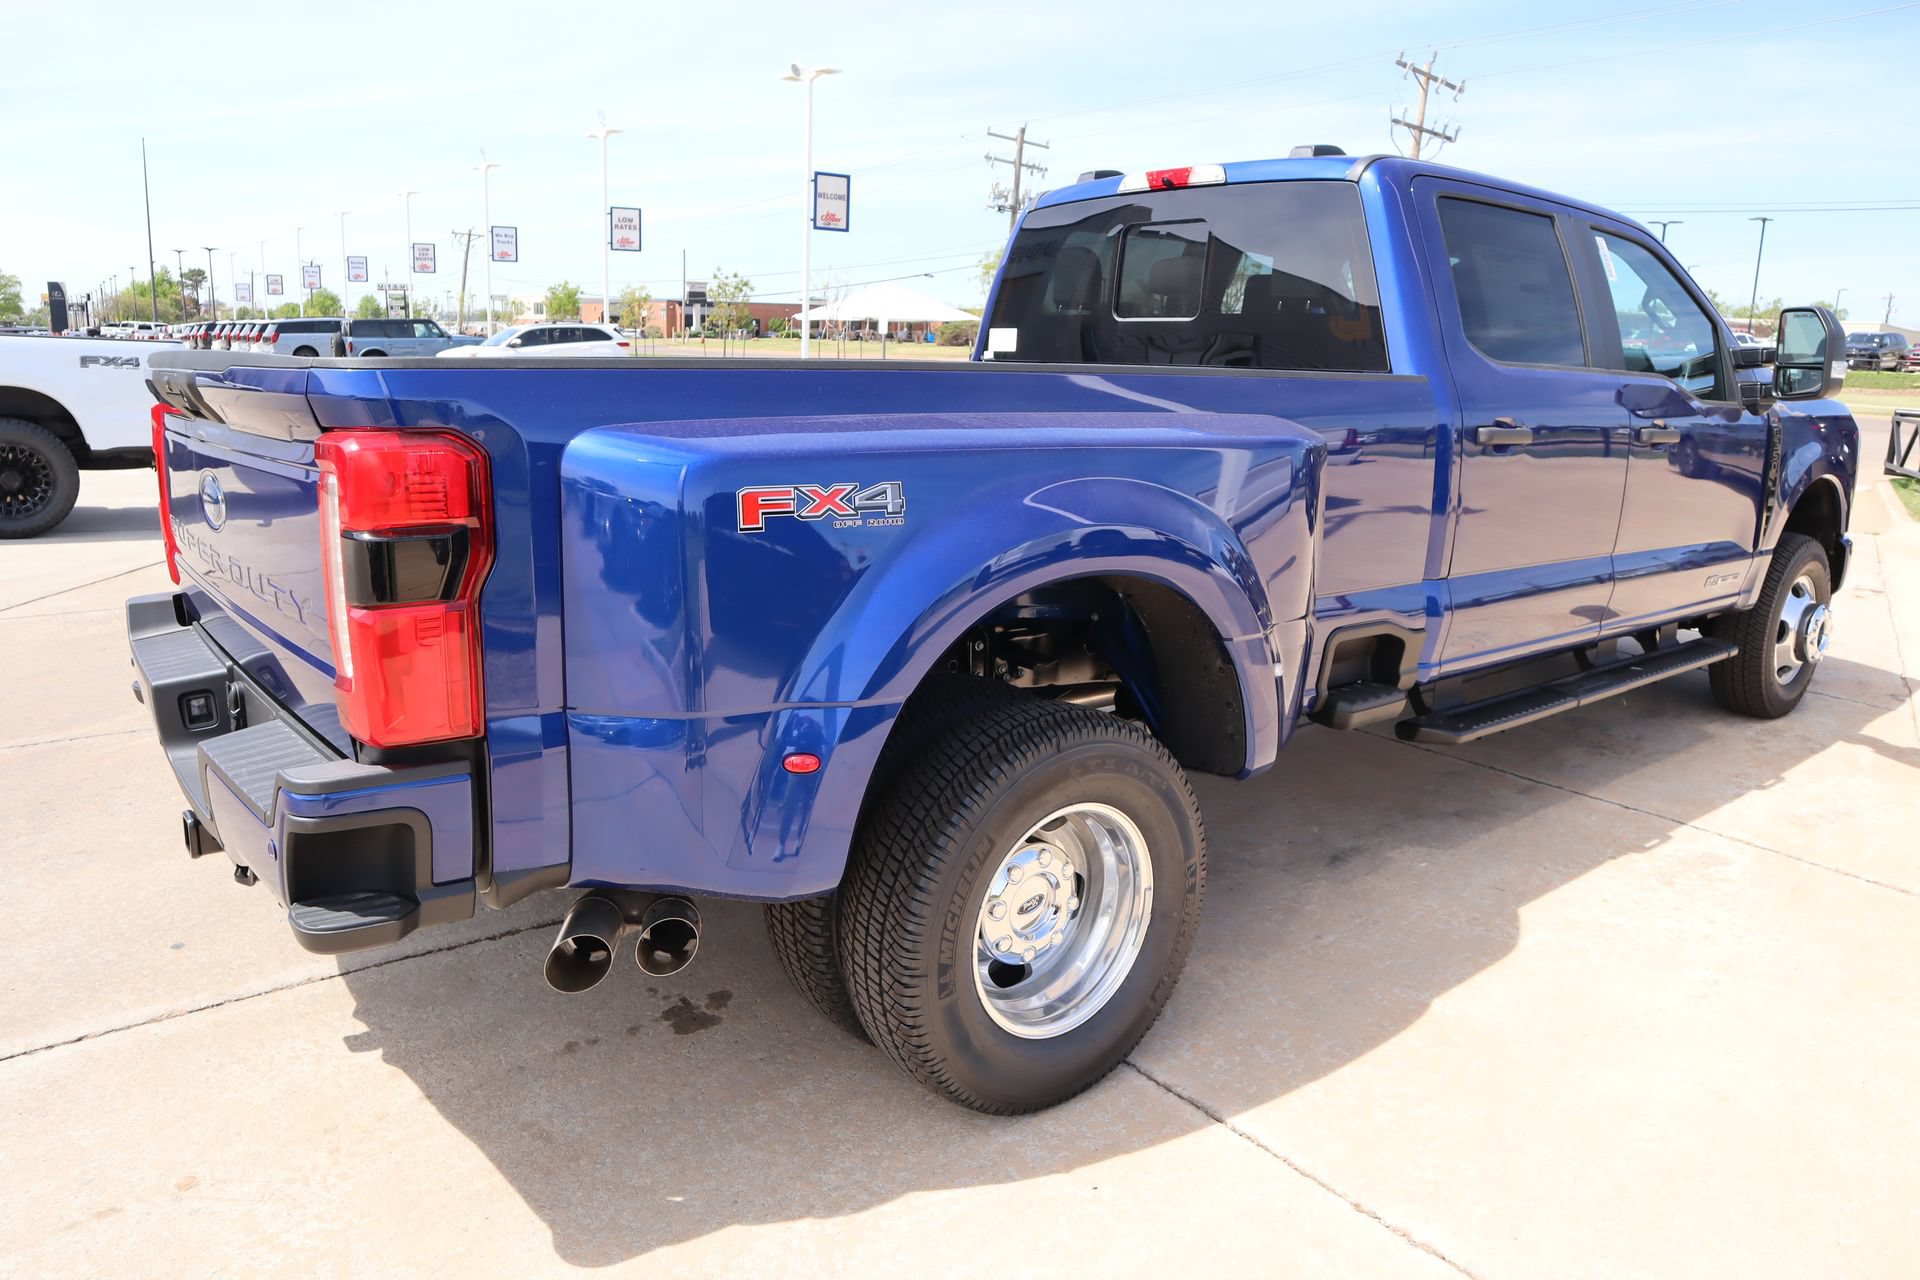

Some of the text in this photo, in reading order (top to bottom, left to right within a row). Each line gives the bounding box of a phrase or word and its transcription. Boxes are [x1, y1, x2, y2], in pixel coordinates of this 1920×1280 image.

[817, 191, 846, 201] WELCOME
[614, 223, 638, 231] RATES
[80, 355, 140, 369] FX4
[736, 481, 906, 533] FX4
[832, 518, 905, 529] OFF ROAD
[169, 513, 313, 626] SUPER DUTY
[938, 833, 996, 967] MICHELIN
